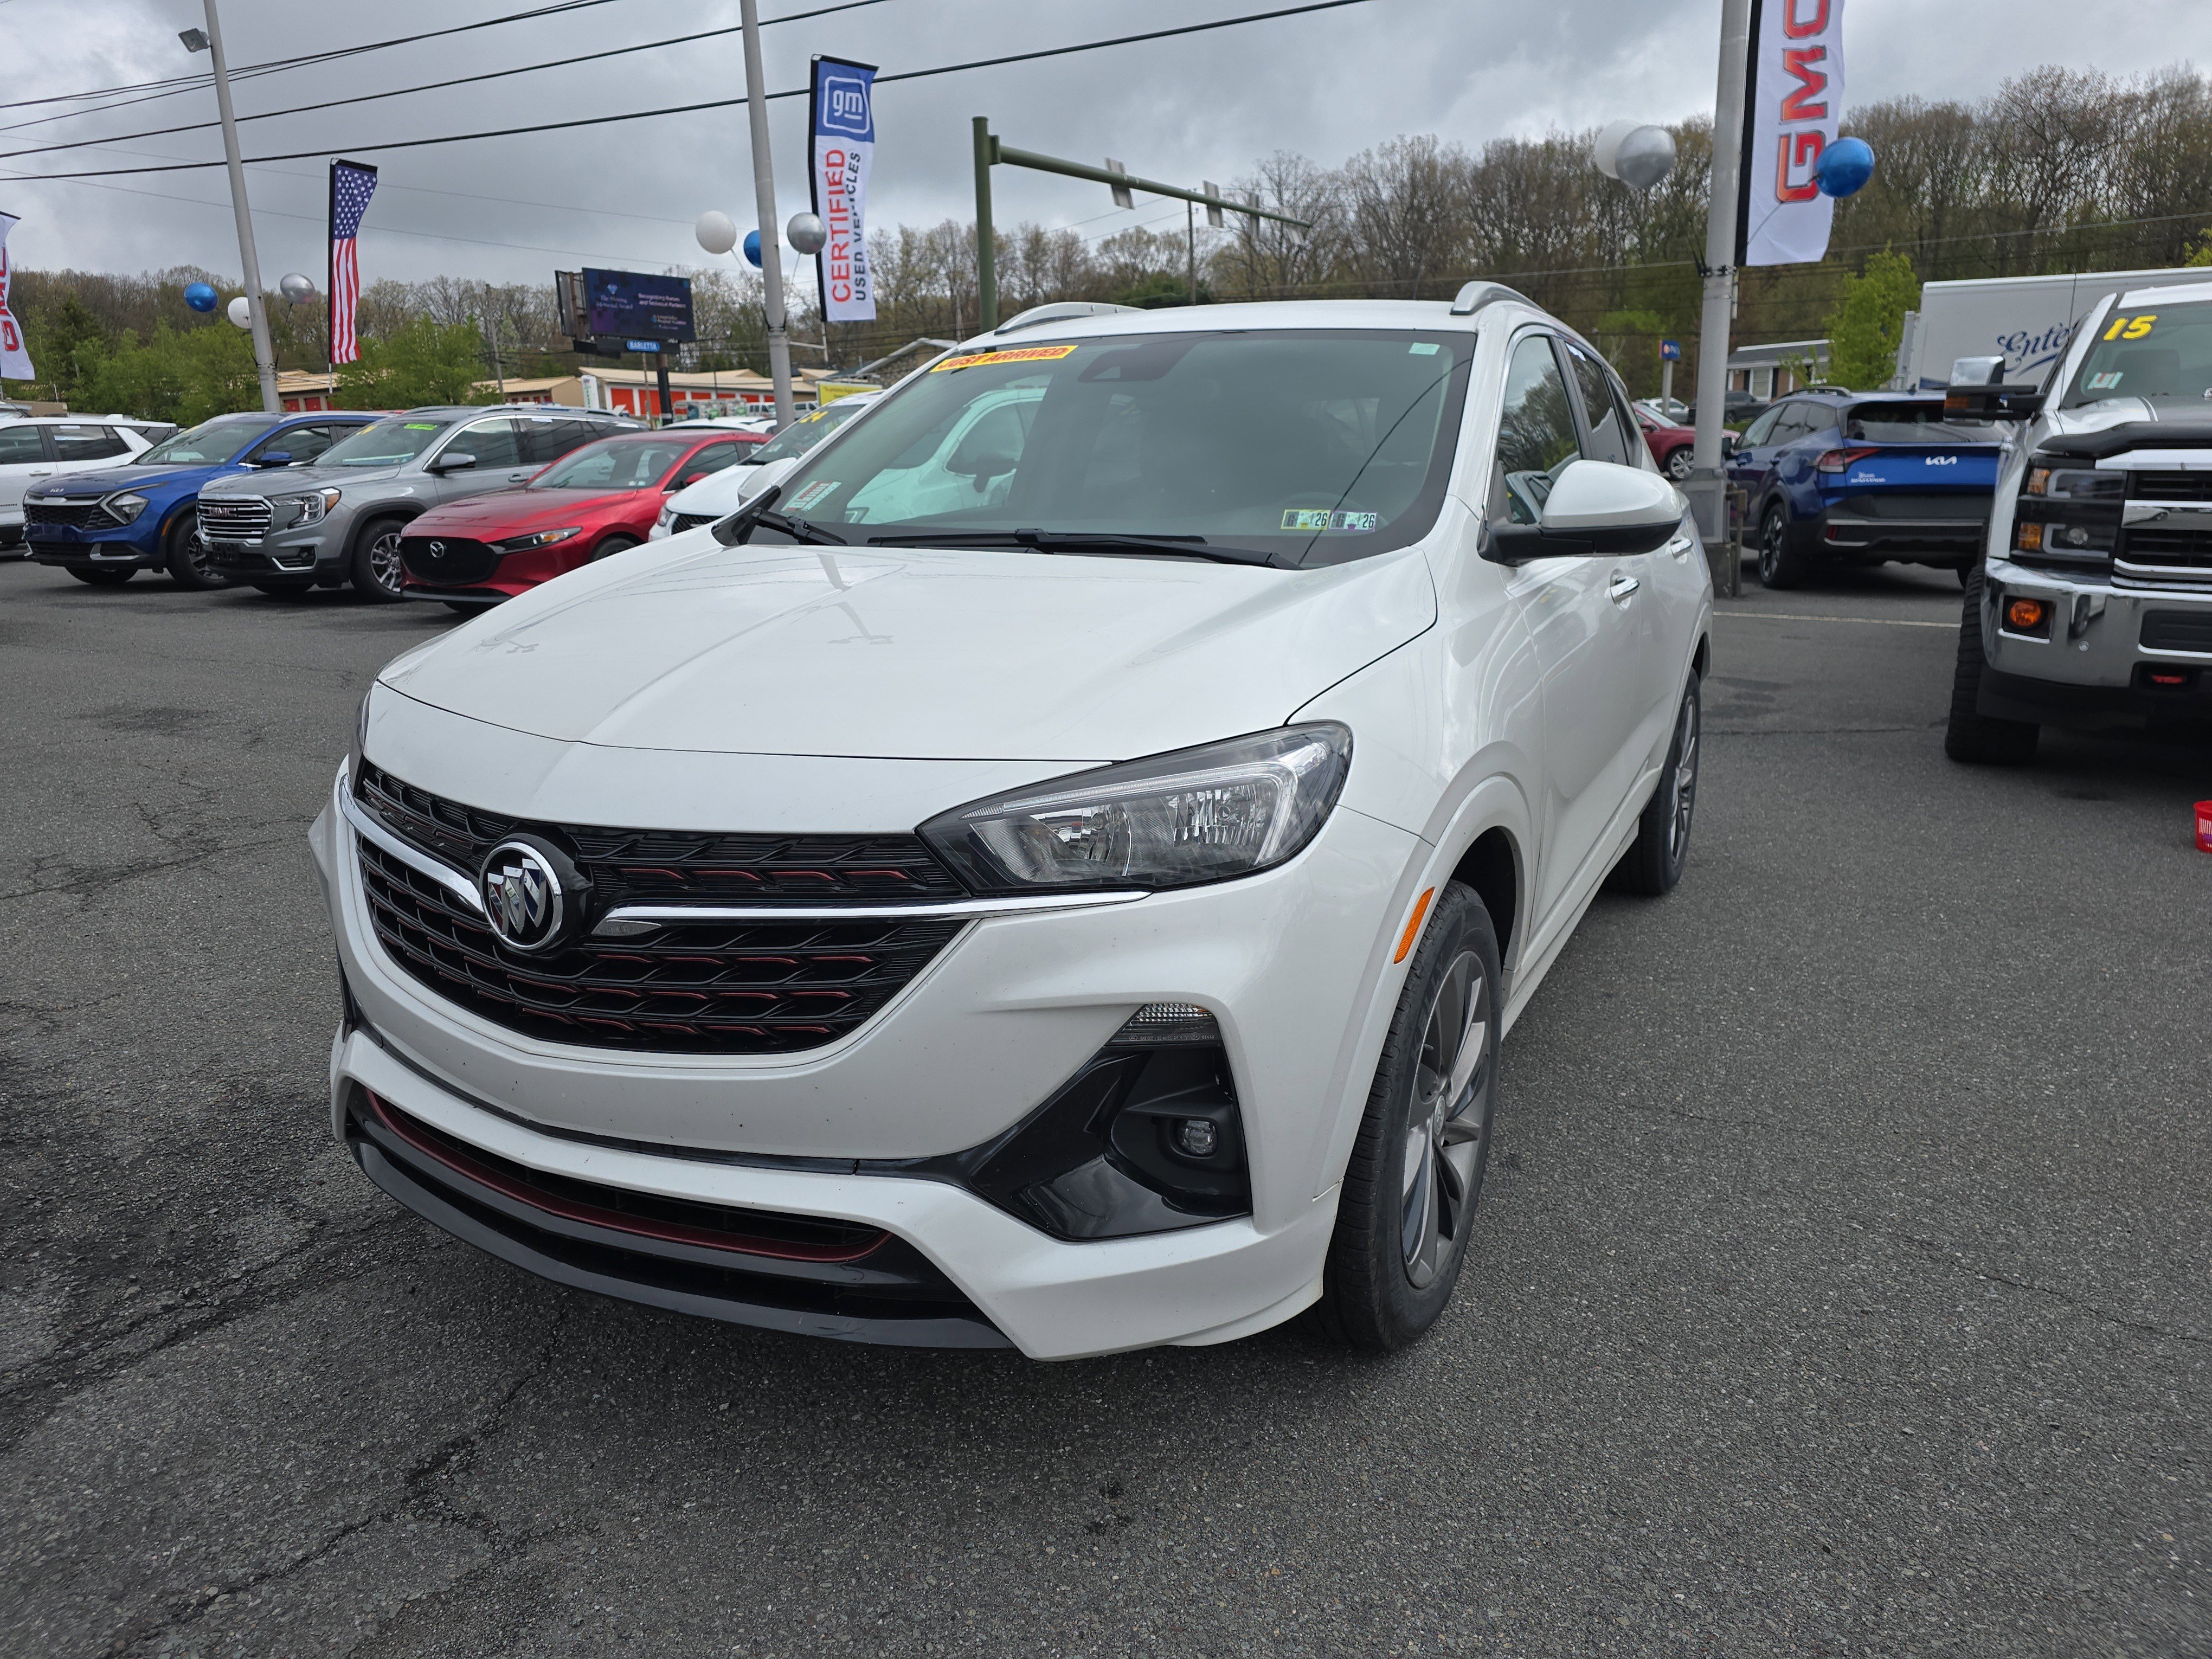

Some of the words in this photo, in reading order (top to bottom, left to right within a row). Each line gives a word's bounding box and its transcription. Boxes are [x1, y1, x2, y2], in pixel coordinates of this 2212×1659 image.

[833, 89, 863, 120] gm
[1774, 0, 1830, 203] GMC
[824, 149, 852, 303] CERTIFIED
[854, 252, 867, 301] USED
[2104, 315, 2158, 340] 15
[938, 354, 989, 369] JUST
[982, 347, 1069, 363] ARRIVED
[1315, 512, 1328, 526] 26
[1362, 514, 1375, 528] 26
